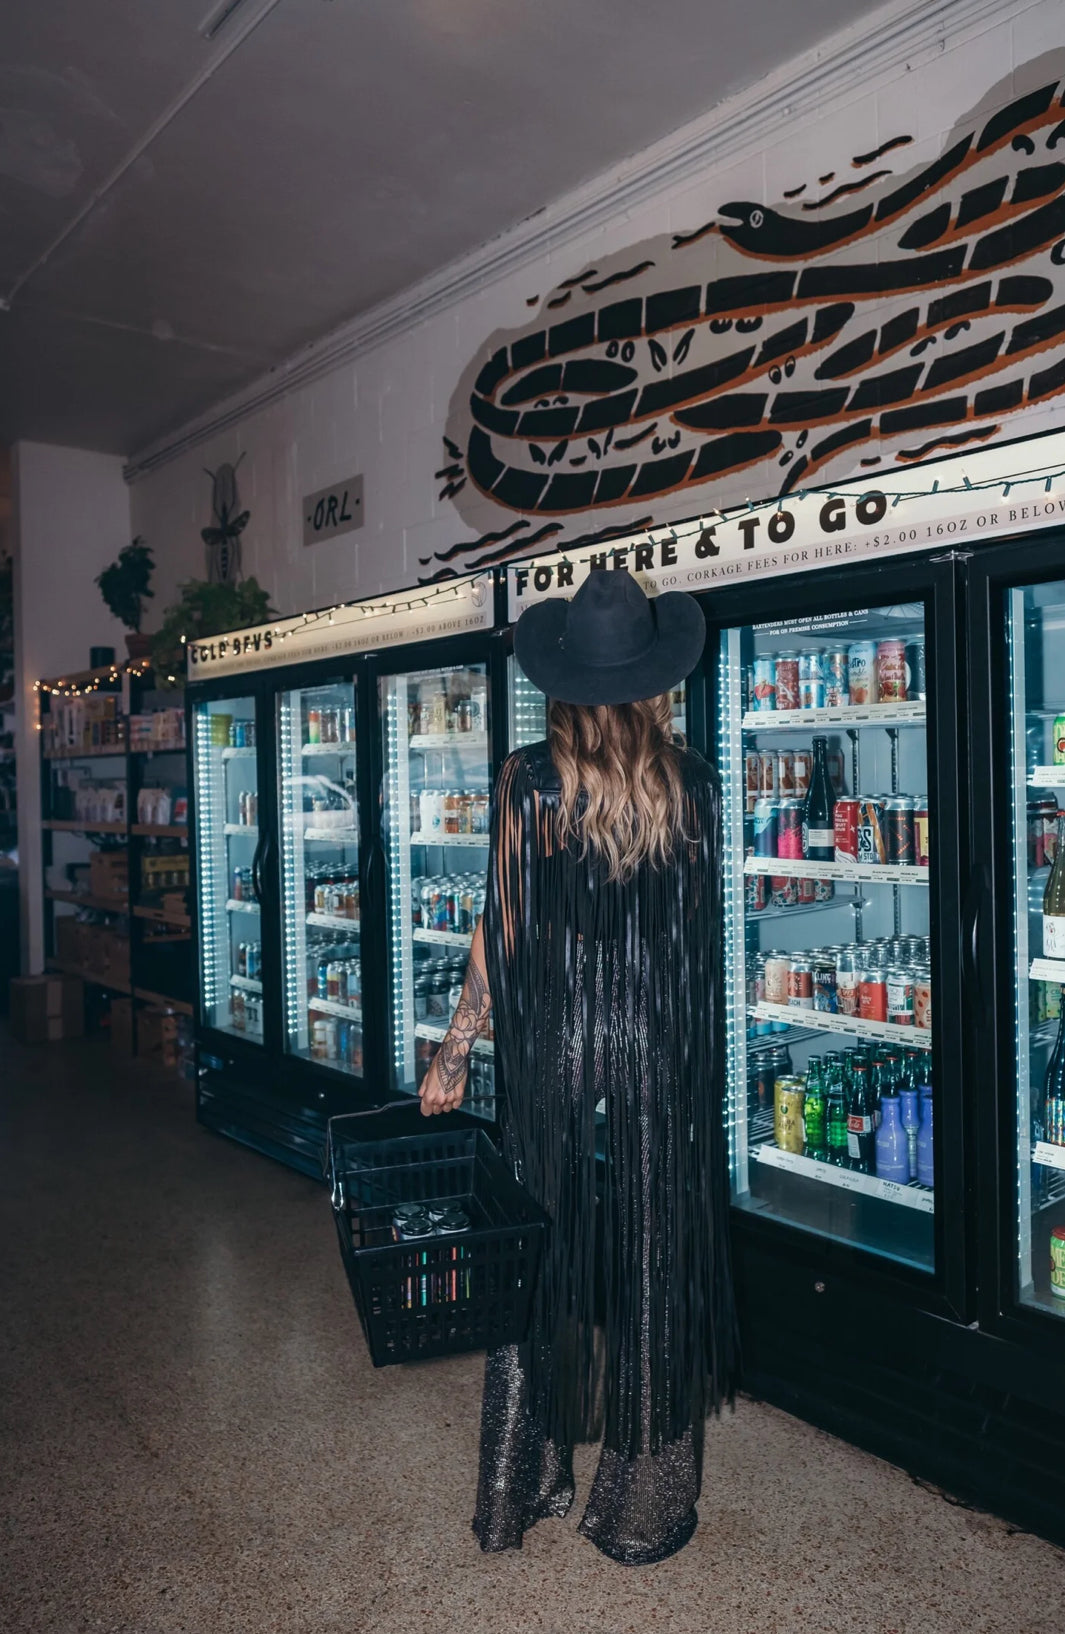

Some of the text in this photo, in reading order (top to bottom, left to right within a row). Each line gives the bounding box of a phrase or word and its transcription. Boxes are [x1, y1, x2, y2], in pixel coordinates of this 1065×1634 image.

[313, 490, 352, 530] ORL
[516, 489, 887, 596] FOR HERE & TO GO
[642, 580, 657, 590] TO
[687, 563, 743, 582] CORKAGE
[747, 557, 778, 571] FEES
[783, 550, 809, 564] FOR
[814, 542, 857, 558] HERE:
[865, 529, 917, 549] +$2.00
[976, 513, 999, 527] OR
[752, 620, 783, 630] BARTENDERS
[798, 616, 812, 624] OPEN
[824, 611, 847, 620] BOTTLES
[854, 608, 869, 616] CANS
[788, 625, 810, 633] PREMISE
[811, 620, 849, 630] CONSUMPTION
